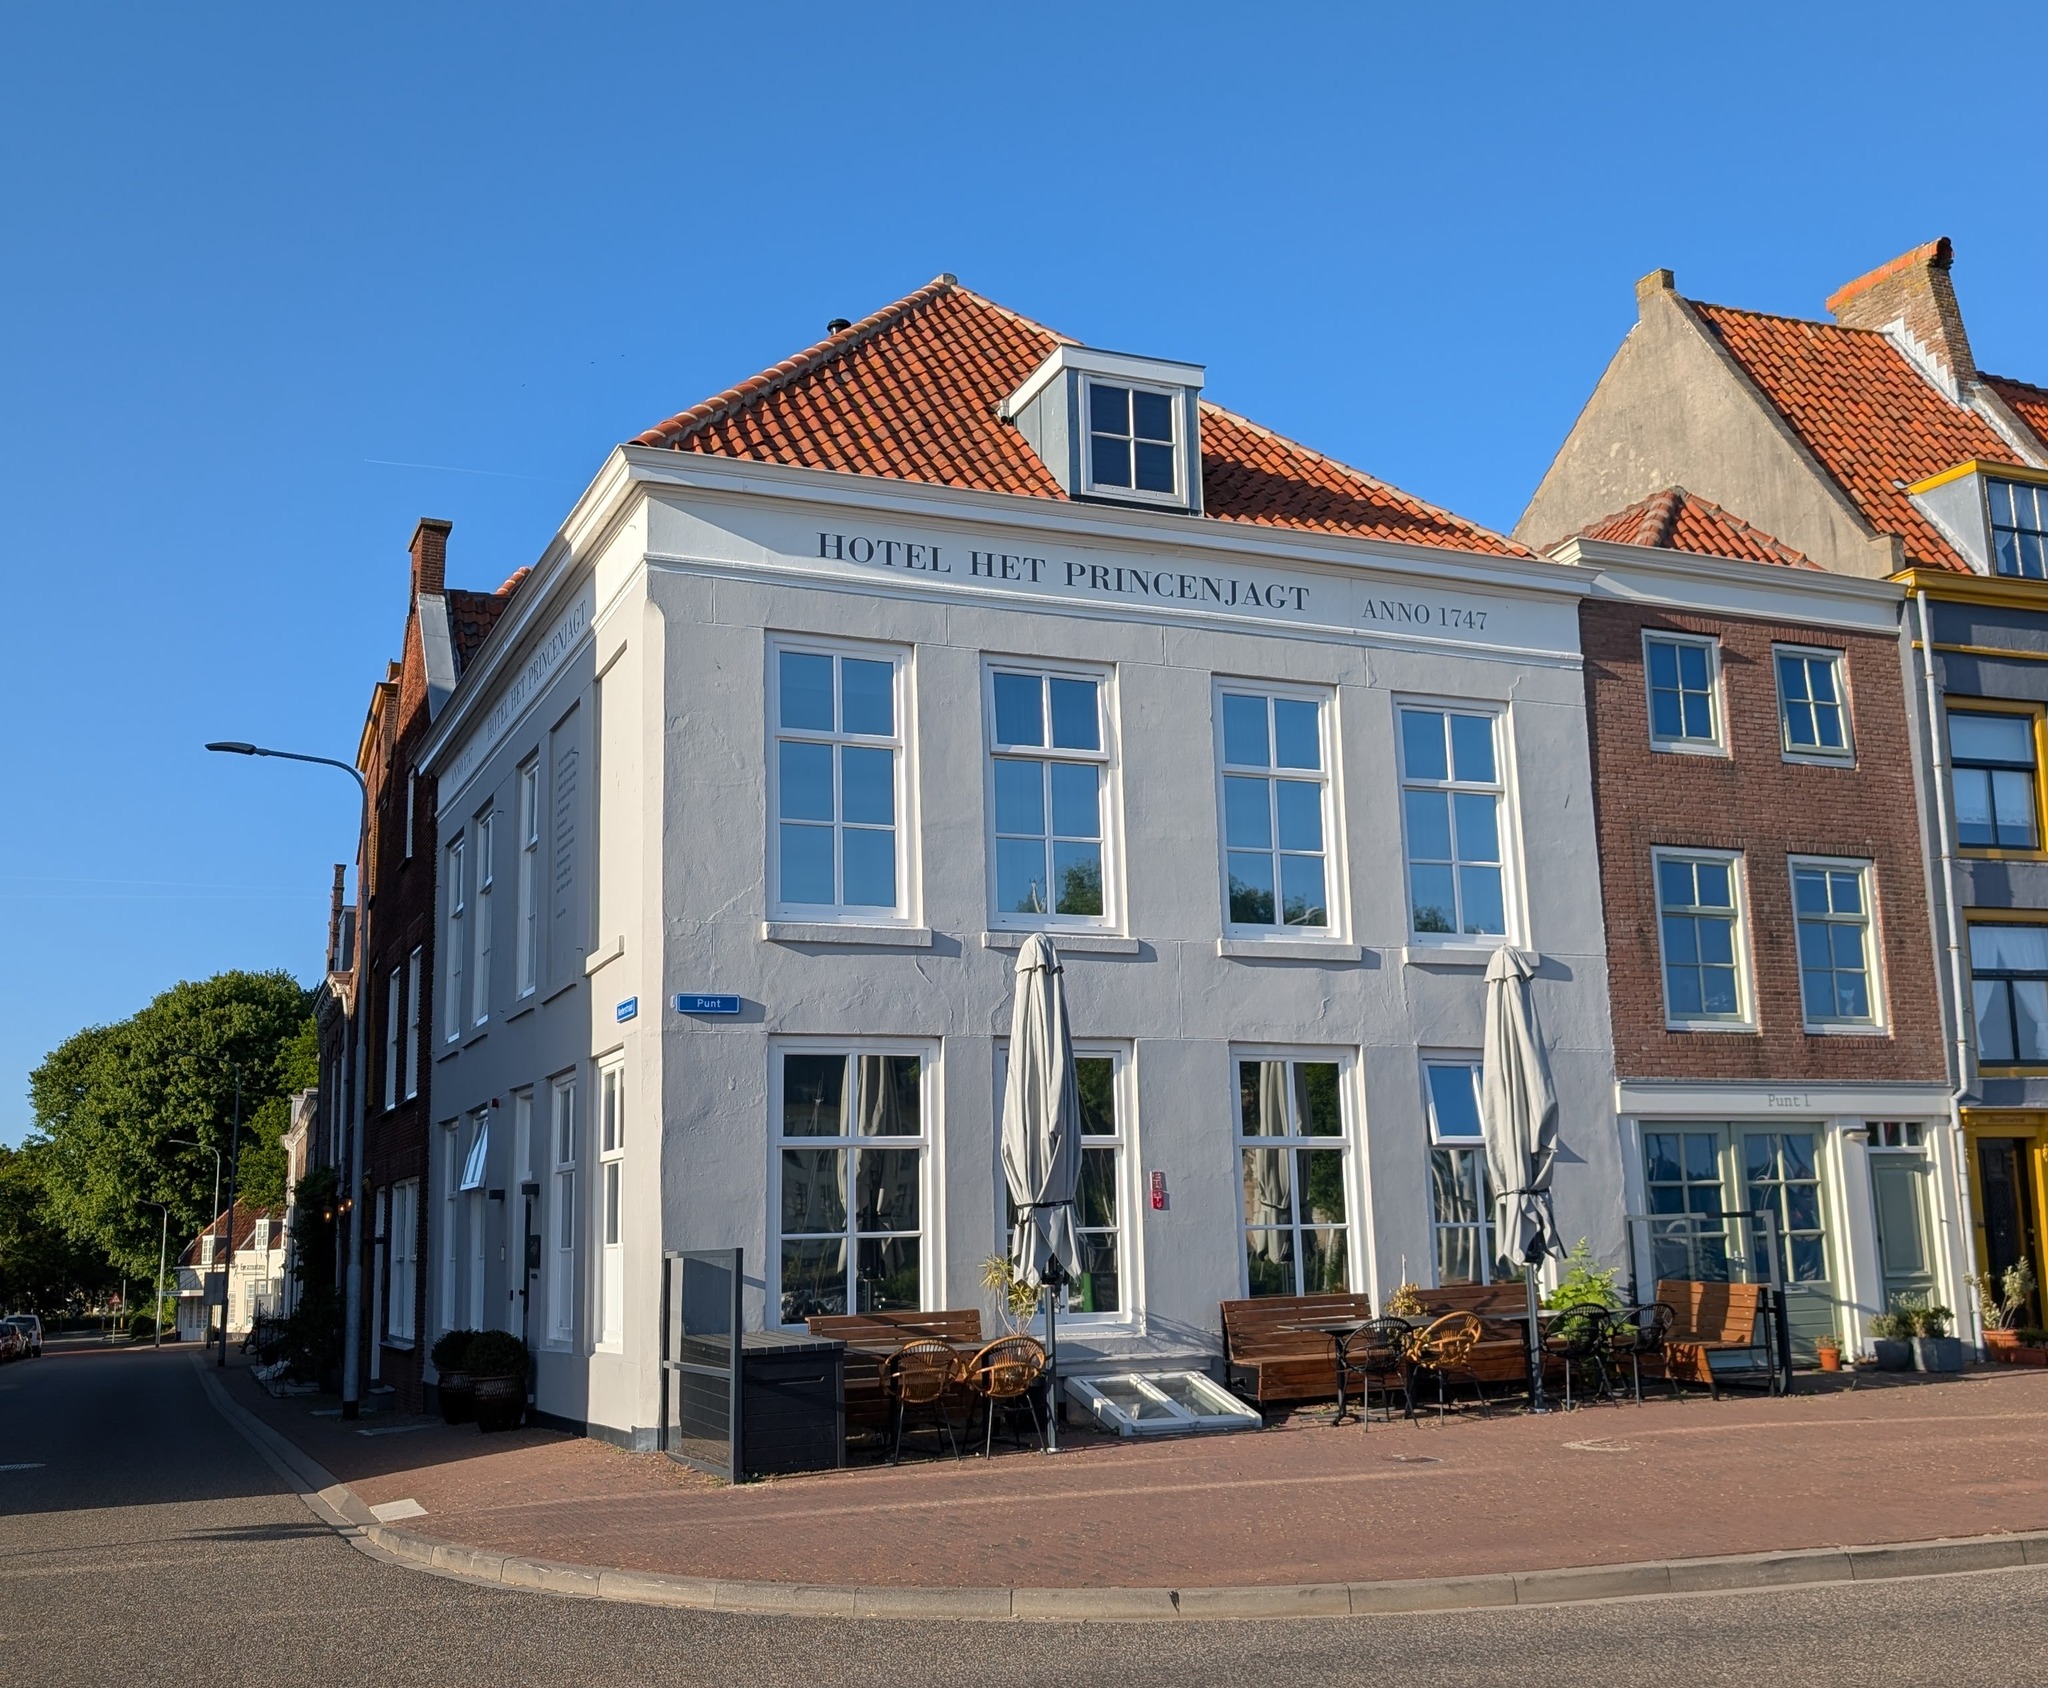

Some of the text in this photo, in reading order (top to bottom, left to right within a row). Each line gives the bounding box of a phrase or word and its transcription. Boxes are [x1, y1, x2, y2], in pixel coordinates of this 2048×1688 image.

[816, 532, 1310, 611] HOTEL HET PRINCENJAGT
[1361, 599, 1488, 630] ANNO 1747
[487, 599, 587, 742] HOTEL HET PRINCENJAGT
[697, 998, 721, 1008] Punt
[1767, 1093, 1801, 1107] Punt
